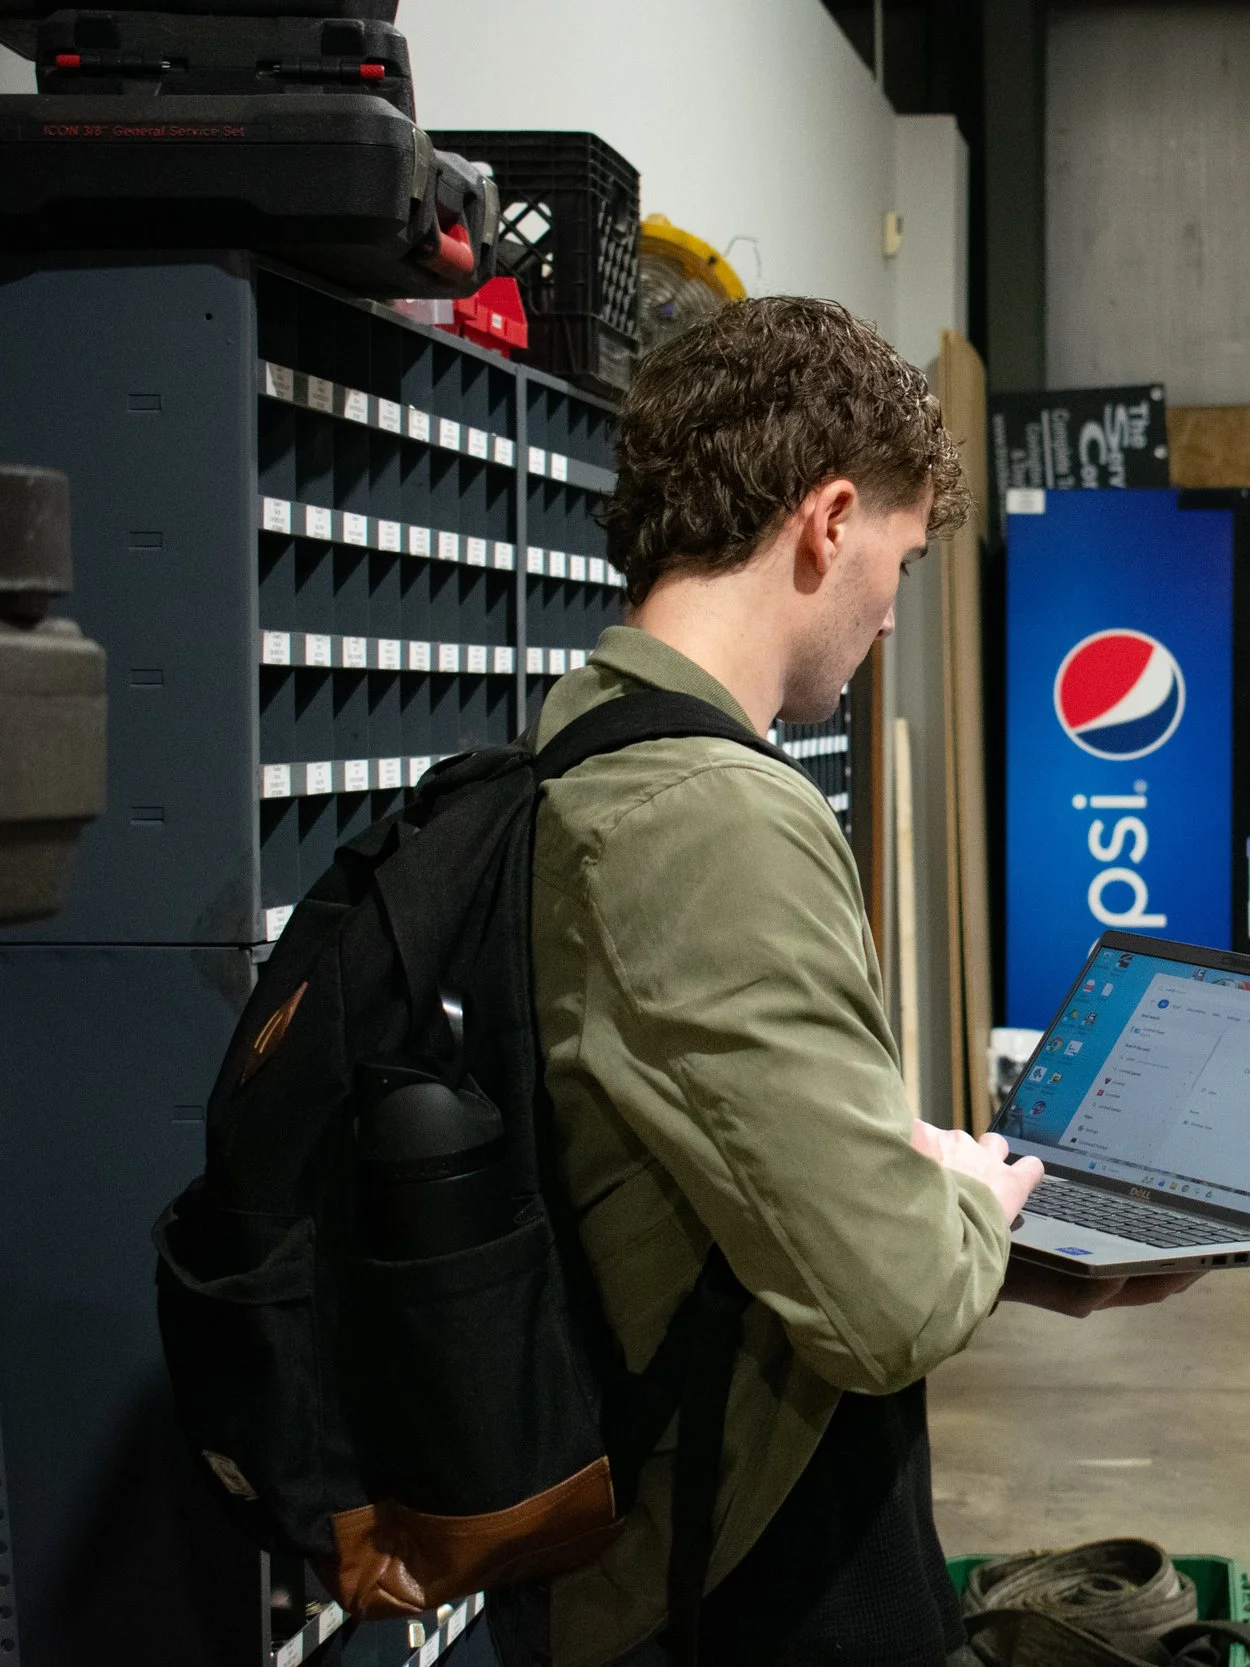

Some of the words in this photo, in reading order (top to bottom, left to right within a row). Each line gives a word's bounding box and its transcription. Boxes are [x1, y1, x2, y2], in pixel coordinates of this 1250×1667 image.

[43, 125, 79, 136] ICON
[113, 125, 165, 136] General
[169, 125, 218, 136] Service
[222, 125, 245, 136] Set
[1128, 401, 1150, 449] The
[1072, 794, 1167, 958] psi
